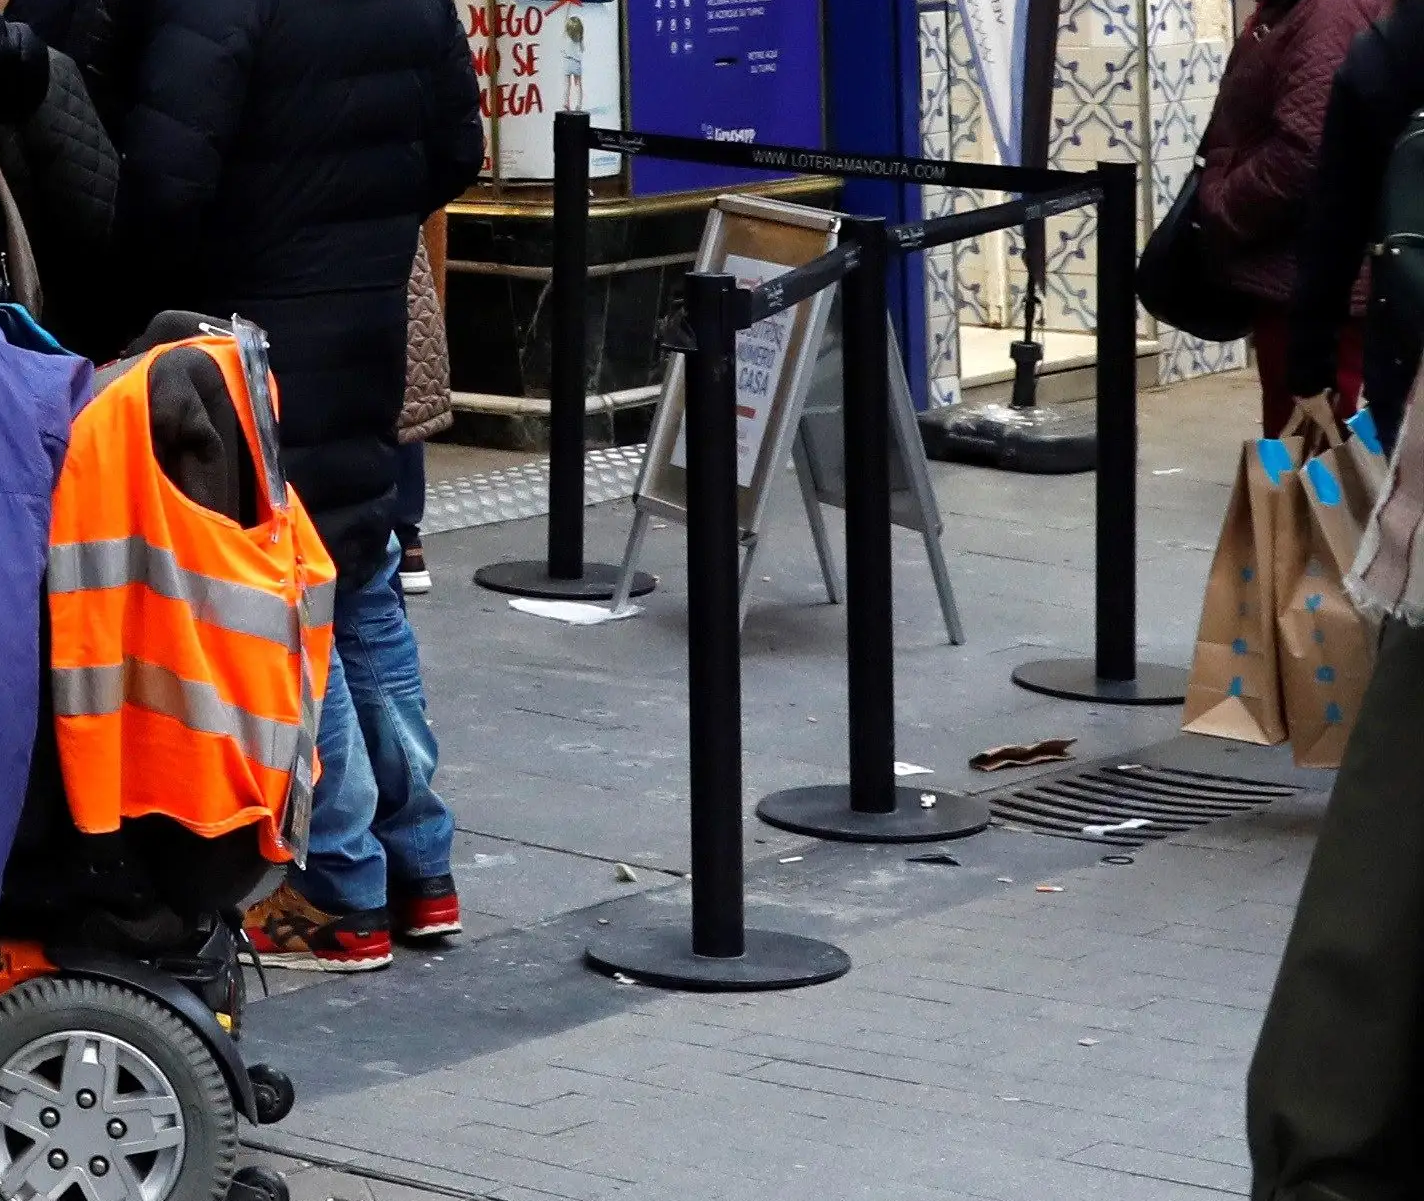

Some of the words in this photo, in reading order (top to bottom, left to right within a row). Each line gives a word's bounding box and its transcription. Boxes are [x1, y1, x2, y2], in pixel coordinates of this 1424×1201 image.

[466, 3, 543, 38] JUEGO
[512, 42, 540, 78] SE
[479, 83, 543, 119] UEGA
